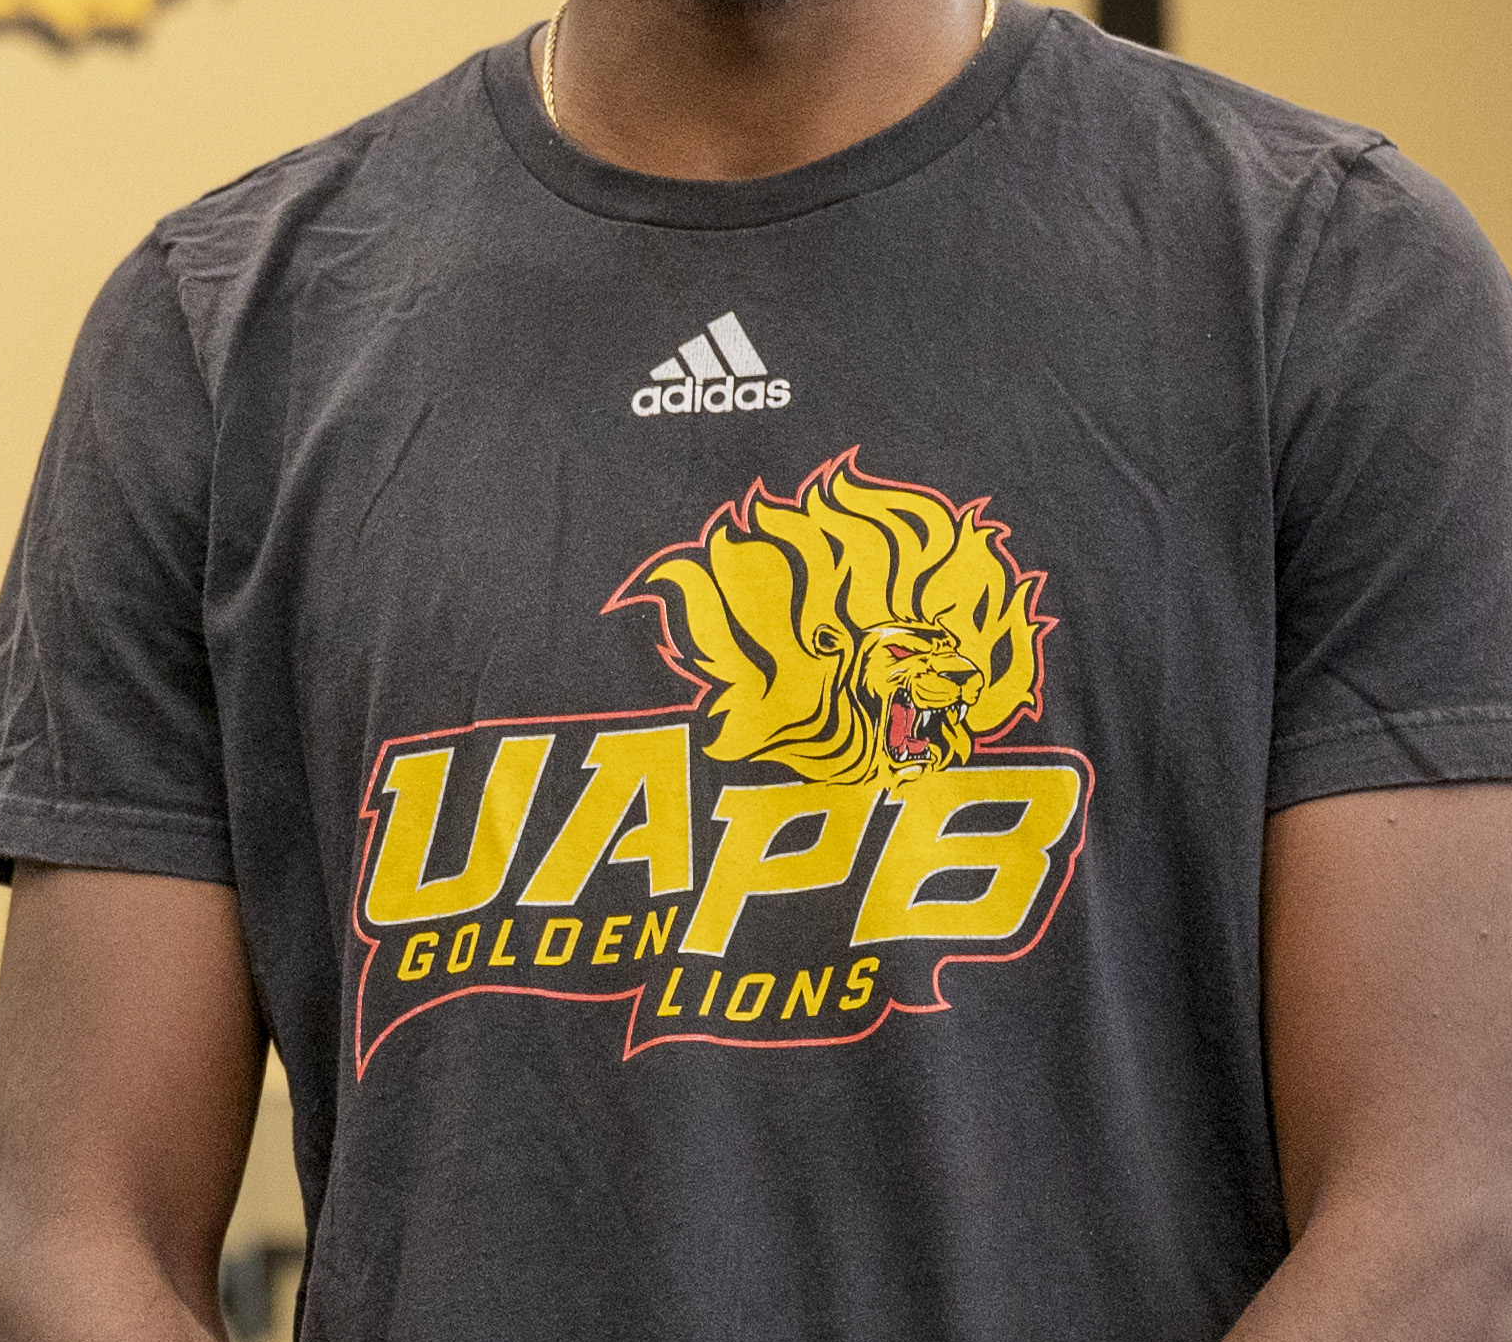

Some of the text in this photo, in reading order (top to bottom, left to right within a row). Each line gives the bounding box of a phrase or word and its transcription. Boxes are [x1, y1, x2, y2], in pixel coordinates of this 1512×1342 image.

[631, 376, 792, 416] adidas
[364, 722, 1082, 956] UAPB
[397, 907, 678, 982] GOLDEN
[656, 958, 880, 1022] LIONS
